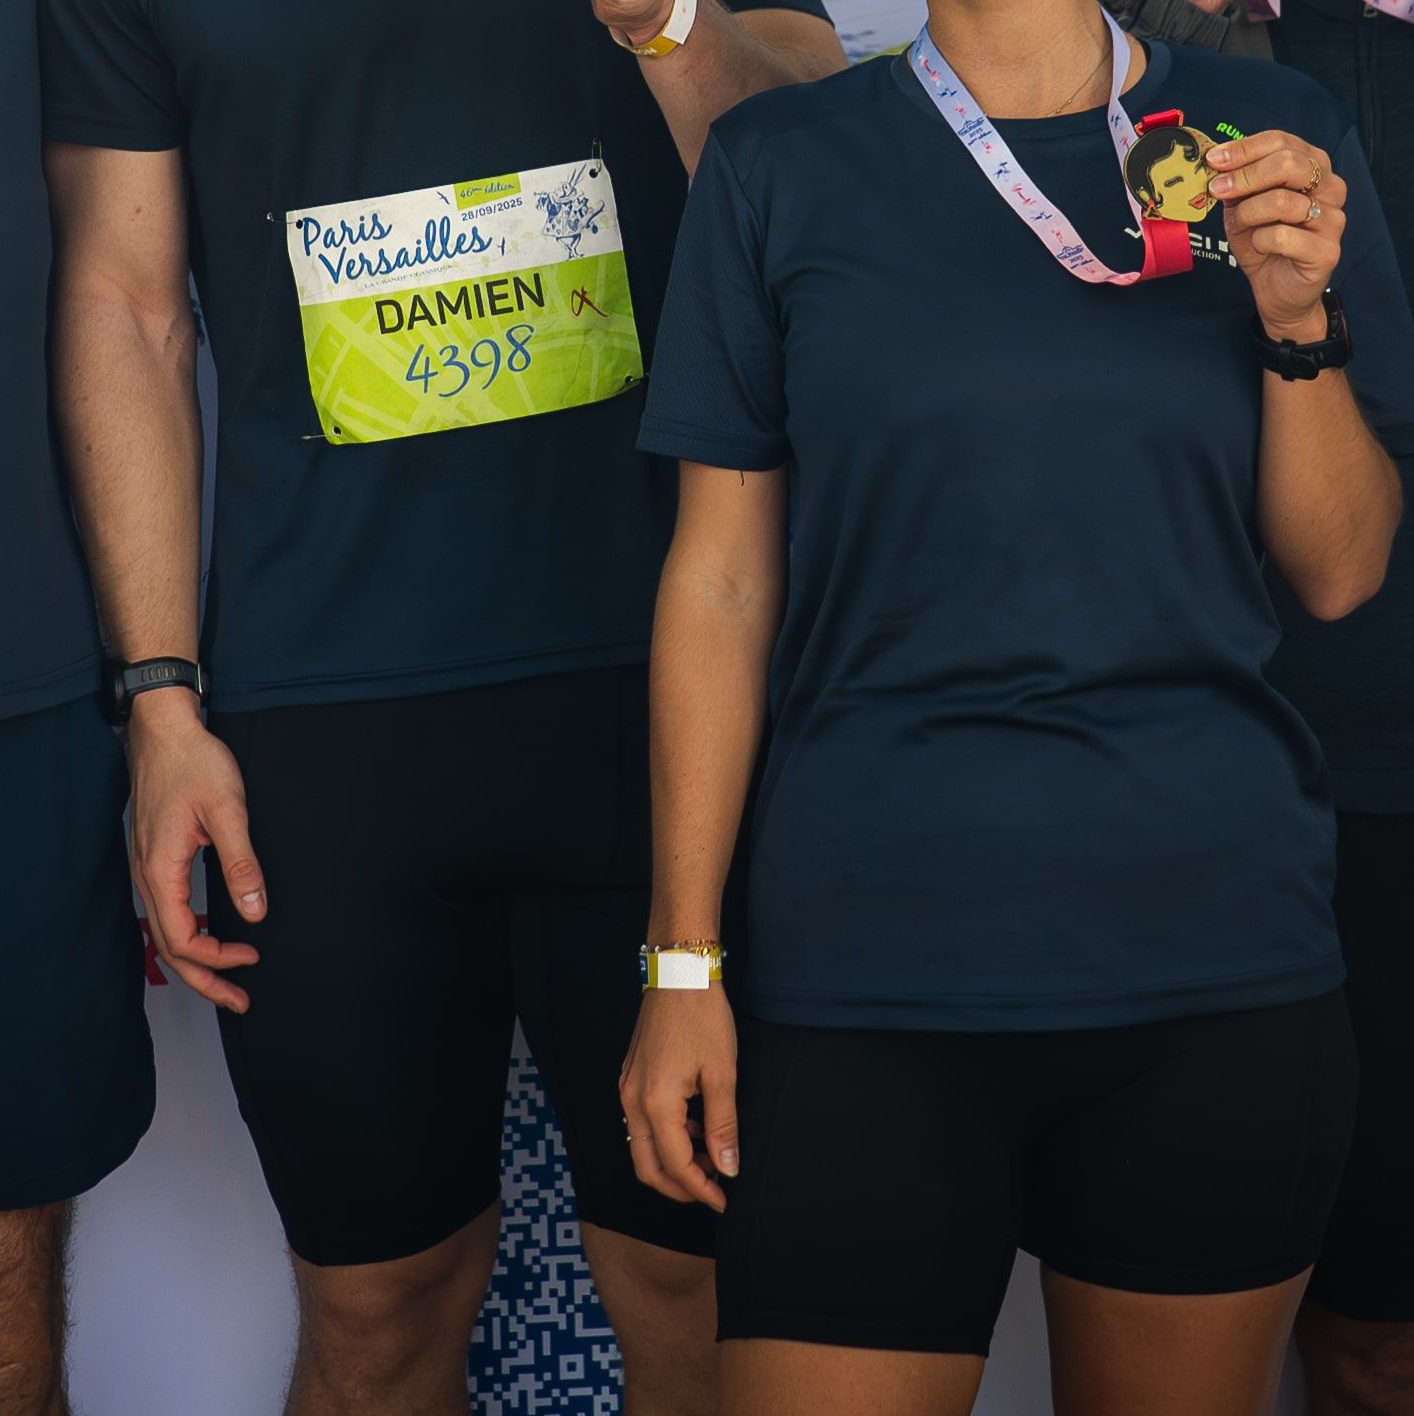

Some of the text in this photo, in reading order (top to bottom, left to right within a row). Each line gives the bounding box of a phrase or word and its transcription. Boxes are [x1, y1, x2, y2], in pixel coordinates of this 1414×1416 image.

[302, 210, 393, 257] Paris
[461, 197, 523, 221] 28/09/2025
[318, 220, 493, 285] Versailles
[374, 272, 545, 335] DAMIEN
[405, 324, 536, 398] 4398
